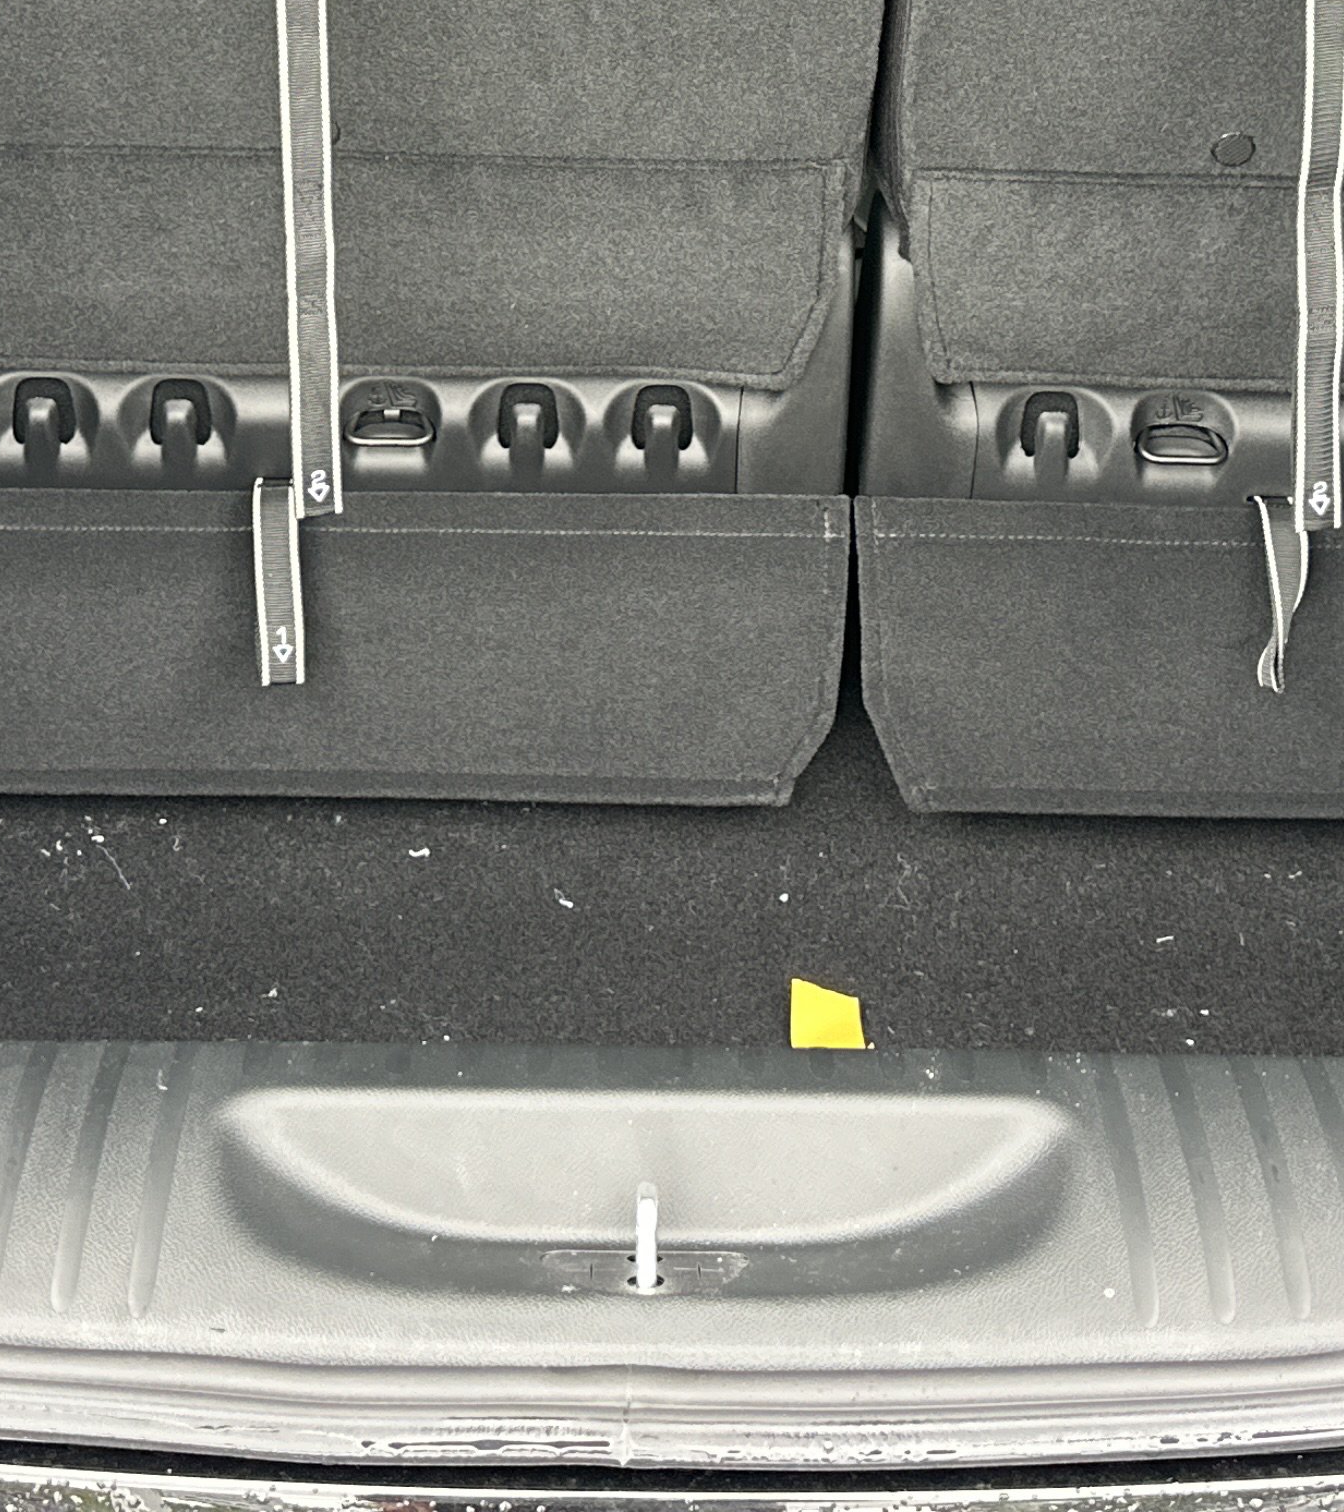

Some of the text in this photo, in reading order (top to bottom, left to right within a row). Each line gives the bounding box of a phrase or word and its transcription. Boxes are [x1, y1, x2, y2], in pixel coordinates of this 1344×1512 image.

[310, 469, 327, 486] 2
[1312, 480, 1328, 497] 2
[275, 625, 287, 645] 1
